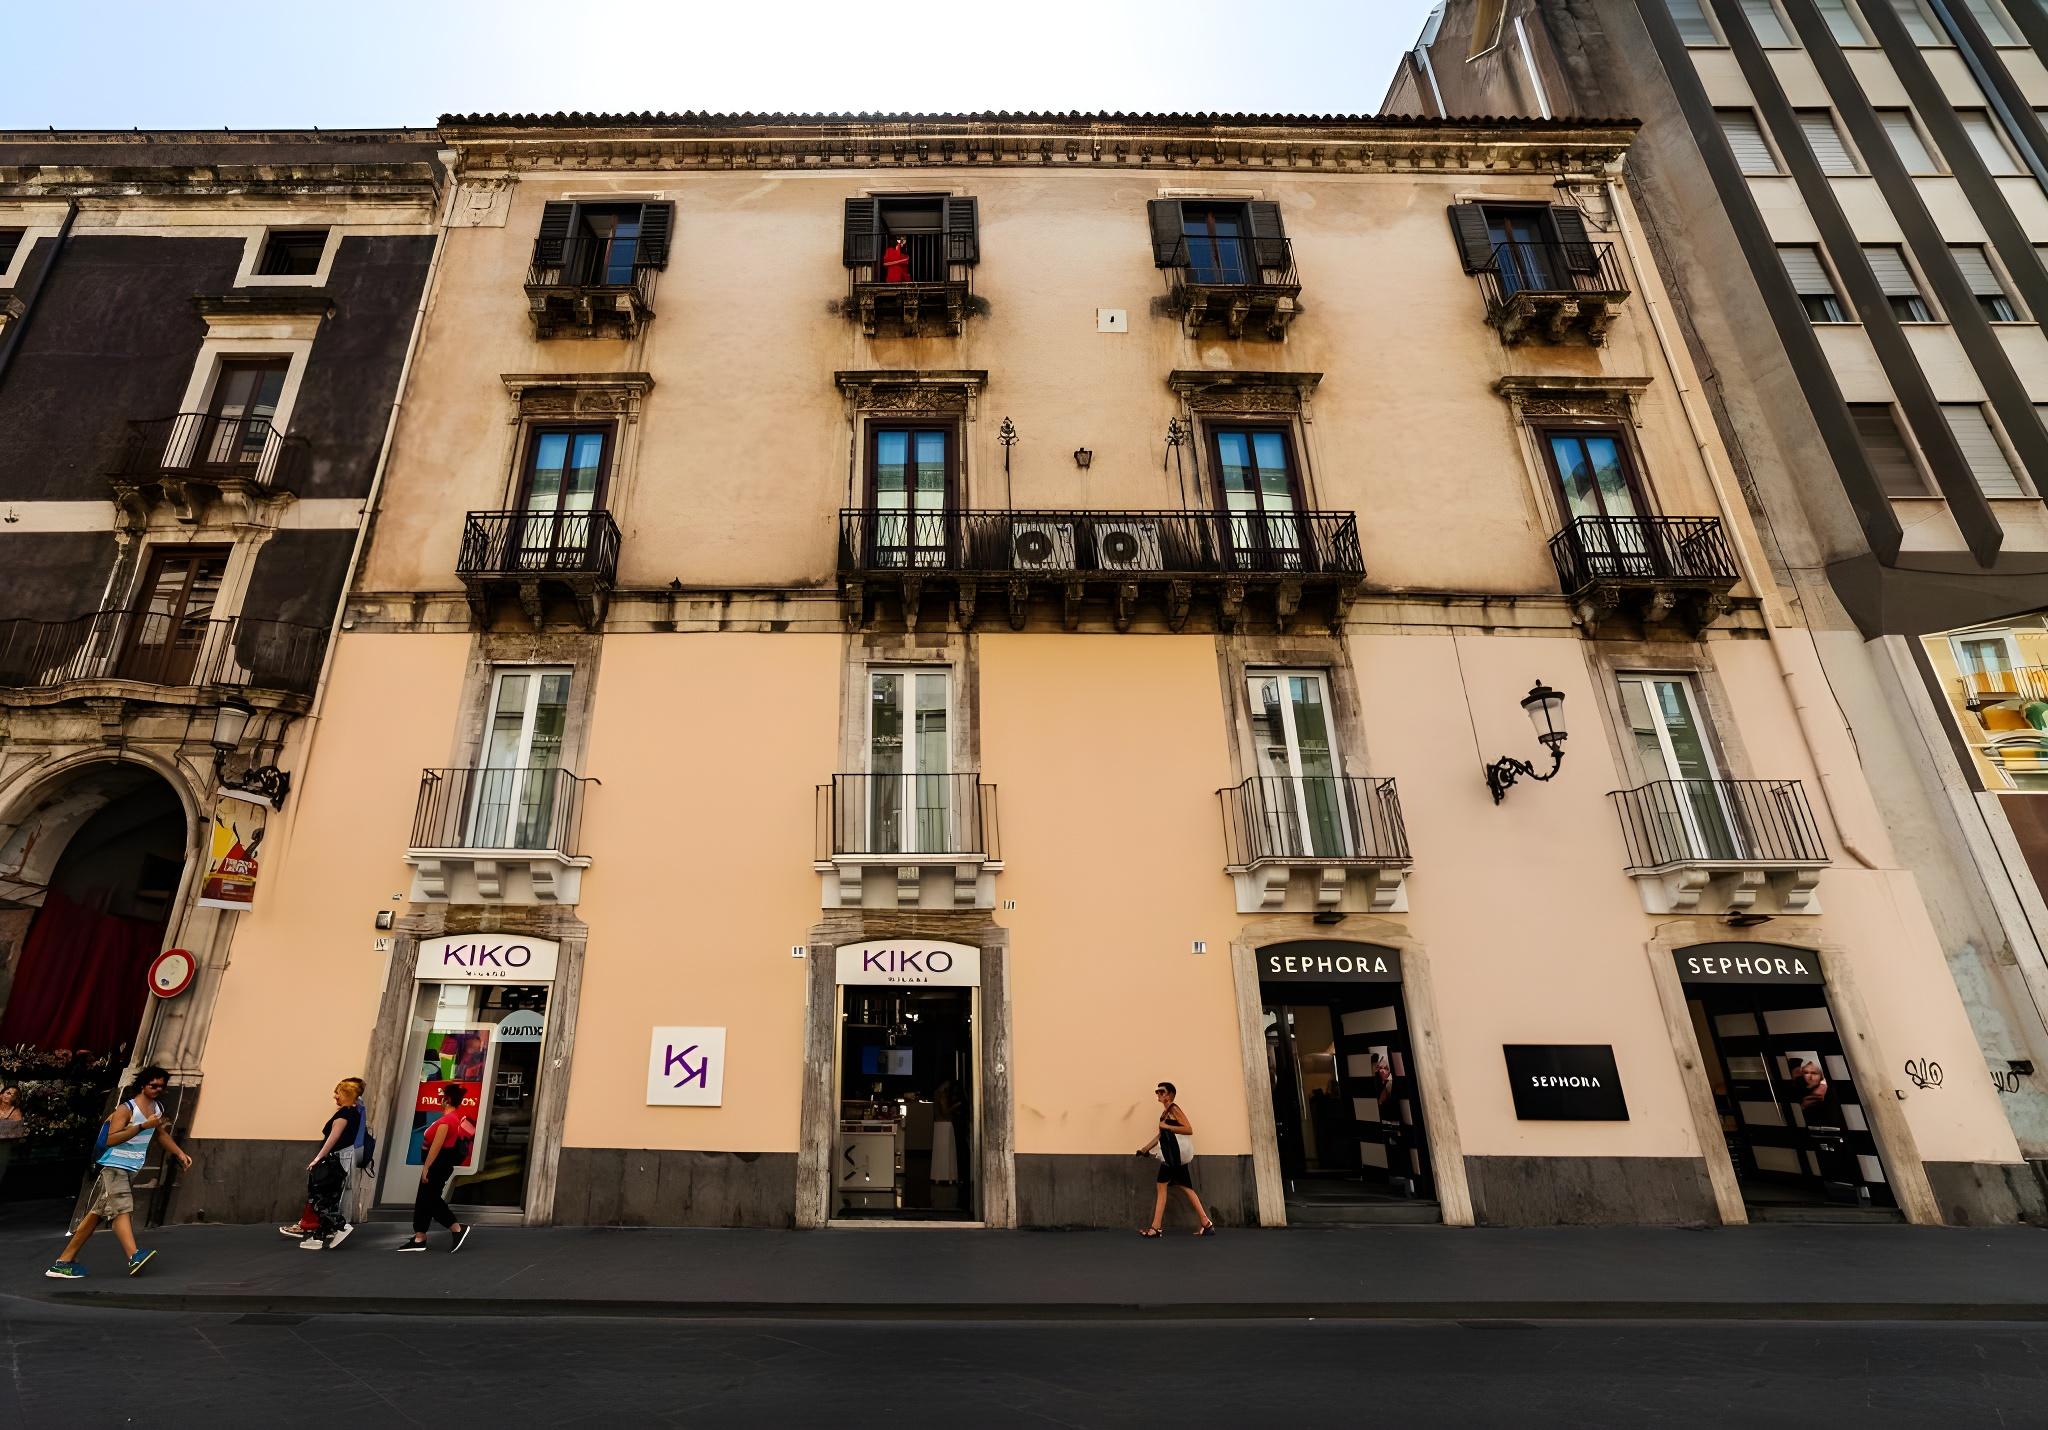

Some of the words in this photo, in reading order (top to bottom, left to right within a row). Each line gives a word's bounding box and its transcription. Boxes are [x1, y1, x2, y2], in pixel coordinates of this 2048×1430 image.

[443, 944, 531, 968] KIKO
[863, 949, 953, 973] KIKO
[1270, 956, 1388, 973] SEPHORA
[1687, 957, 1809, 975] SEPHORA
[1532, 1075, 1601, 1088] SEPHORA
